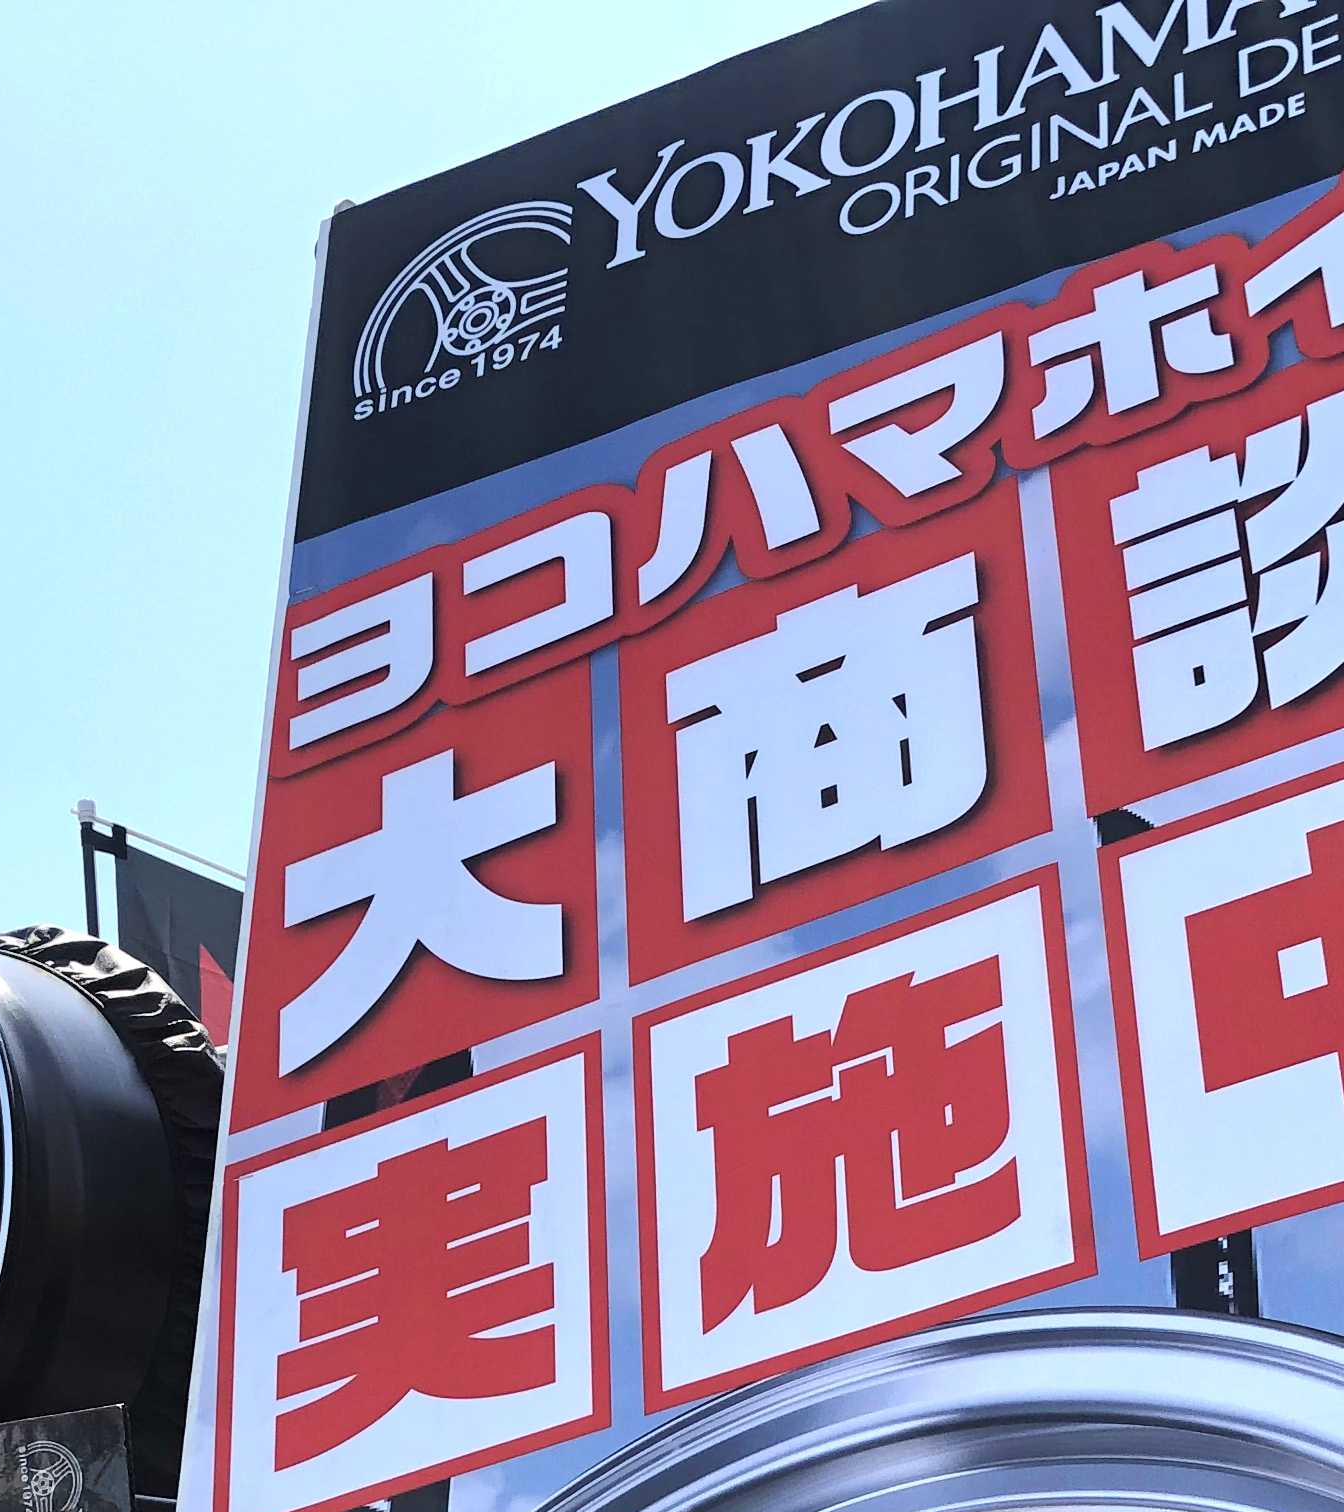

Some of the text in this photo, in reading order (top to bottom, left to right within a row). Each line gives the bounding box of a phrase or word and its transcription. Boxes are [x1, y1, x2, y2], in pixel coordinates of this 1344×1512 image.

[576, 0, 1318, 269] YOKOHAM
[838, 72, 1214, 237] ORIGINAL
[1049, 92, 1306, 201] JAPAN MADE
[353, 325, 563, 421] since 1974
